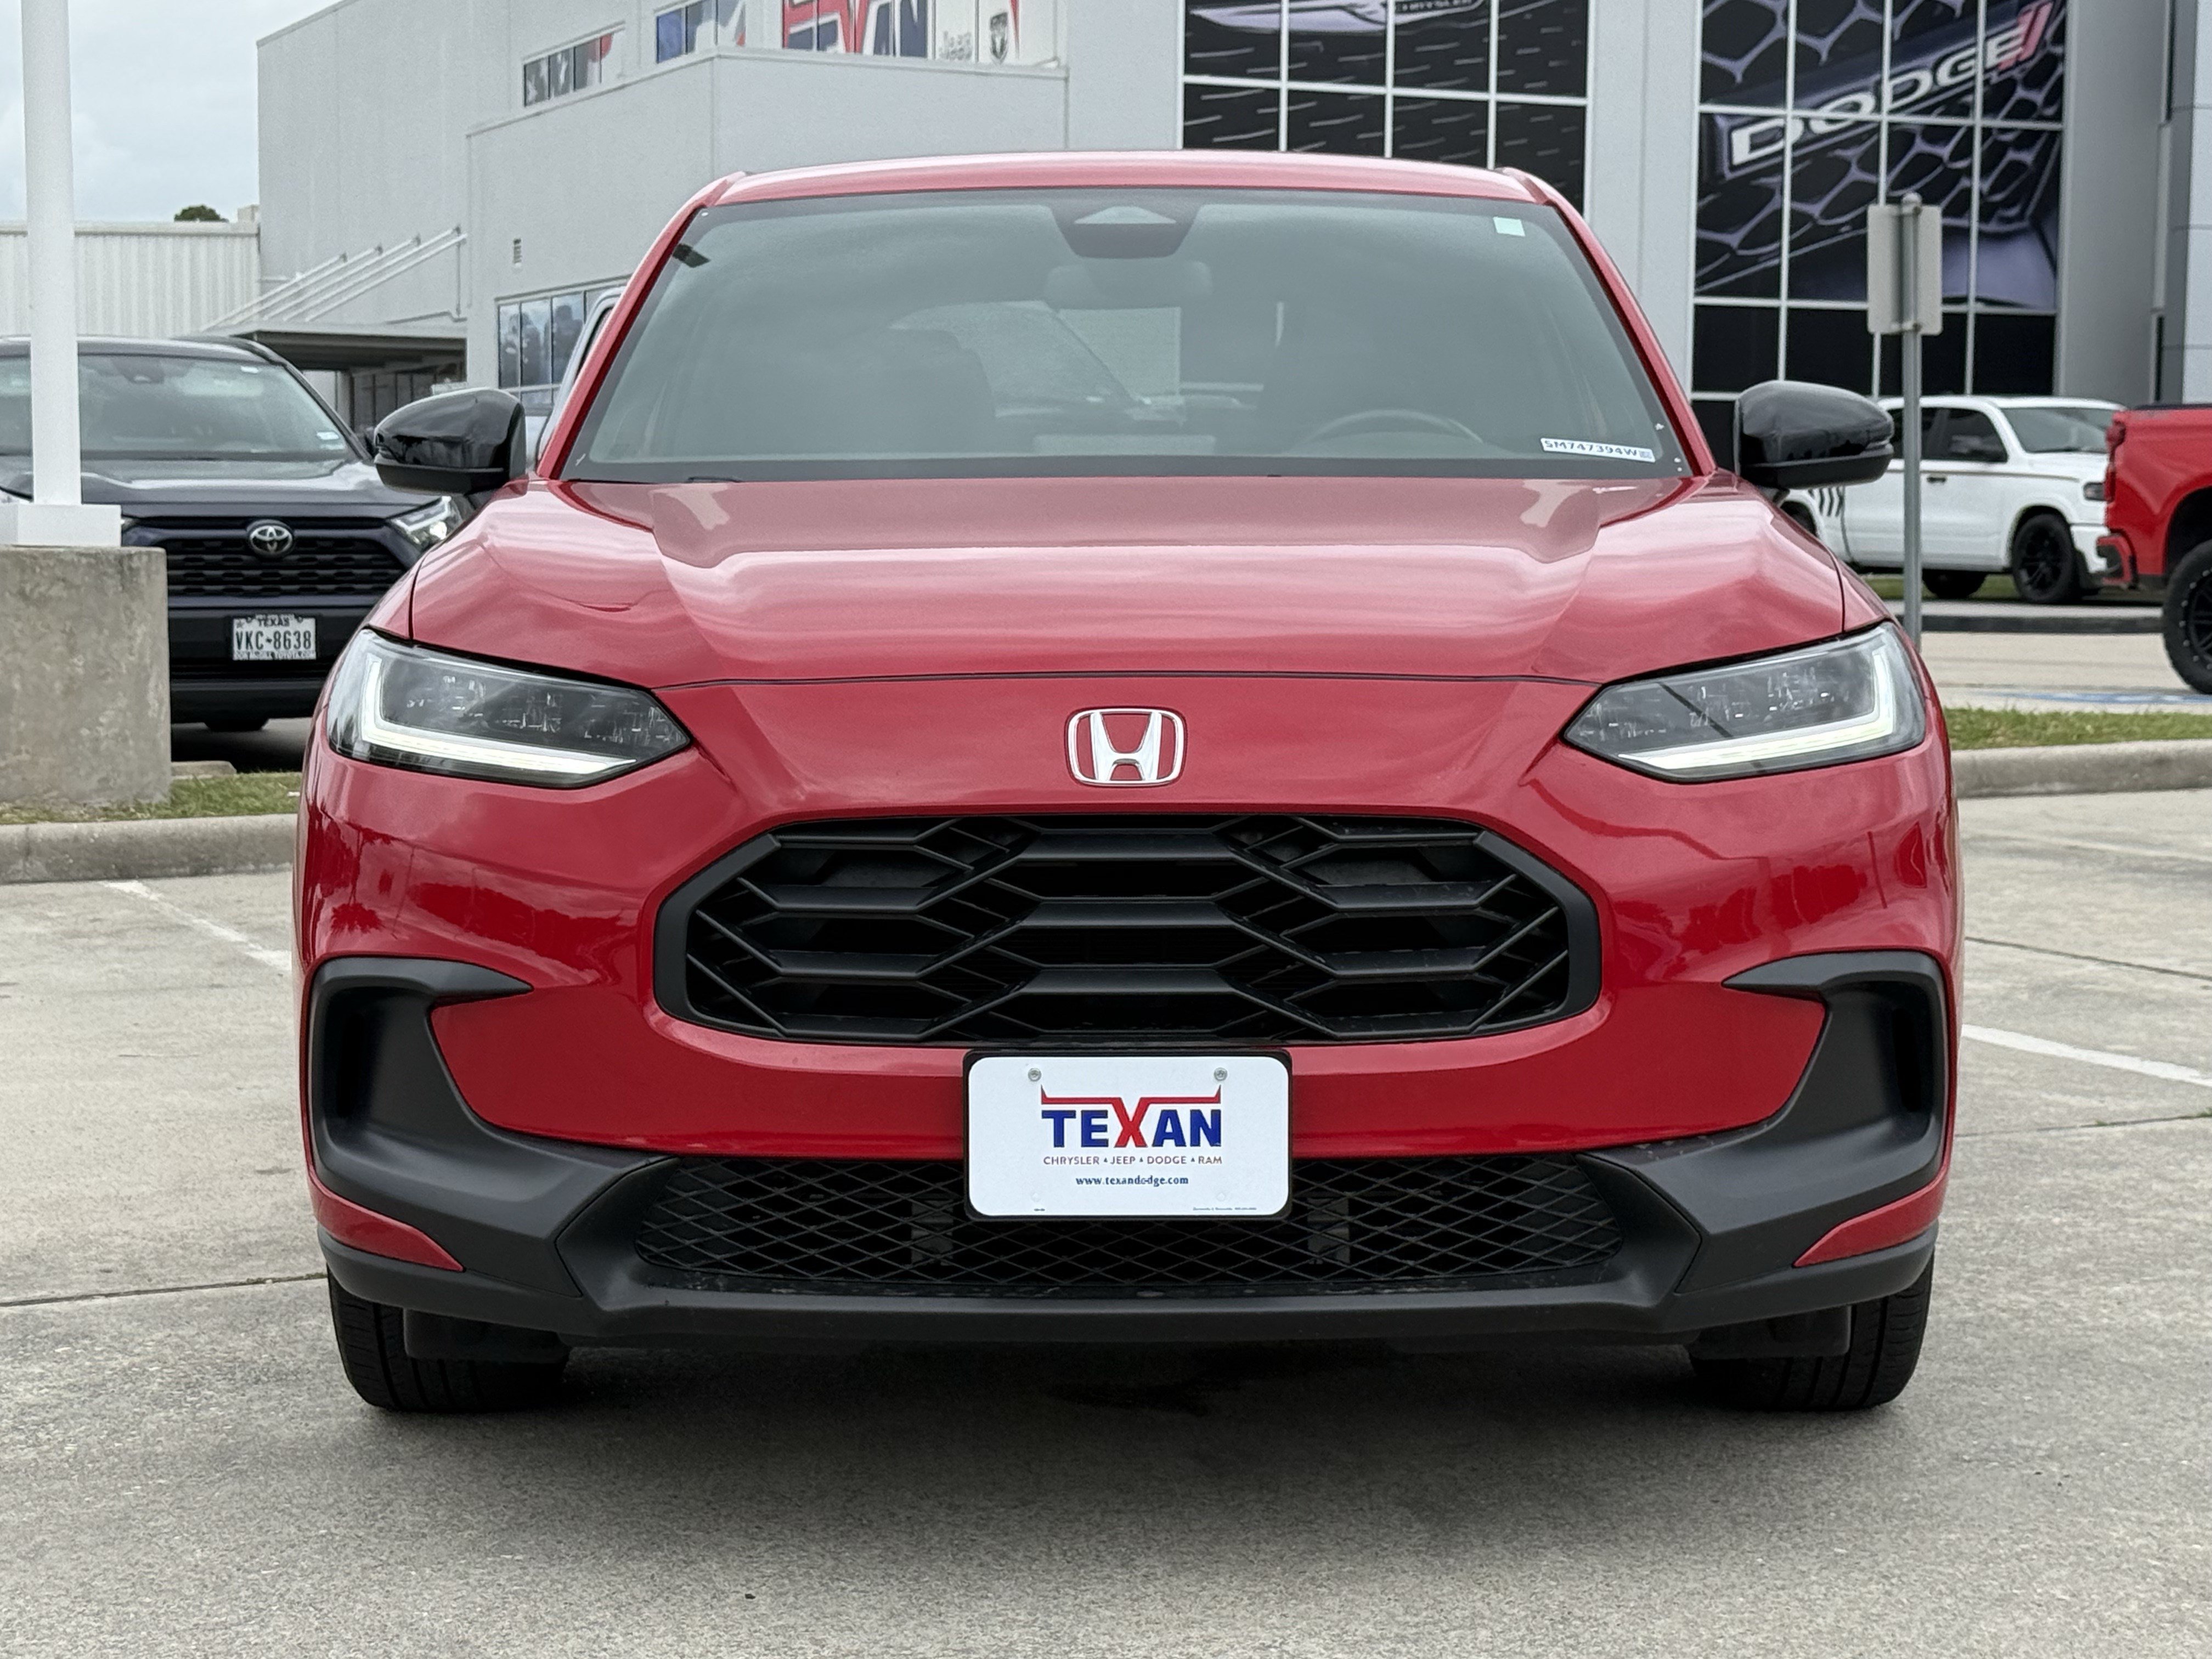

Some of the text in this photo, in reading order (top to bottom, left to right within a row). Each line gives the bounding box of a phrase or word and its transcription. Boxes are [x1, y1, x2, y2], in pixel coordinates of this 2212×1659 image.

[1731, 24, 2025, 165] DODGE
[1041, 1085, 1221, 1148] TEXAN
[1043, 1155, 1222, 1165] CHRYSLER JEEP DODGE RAM
